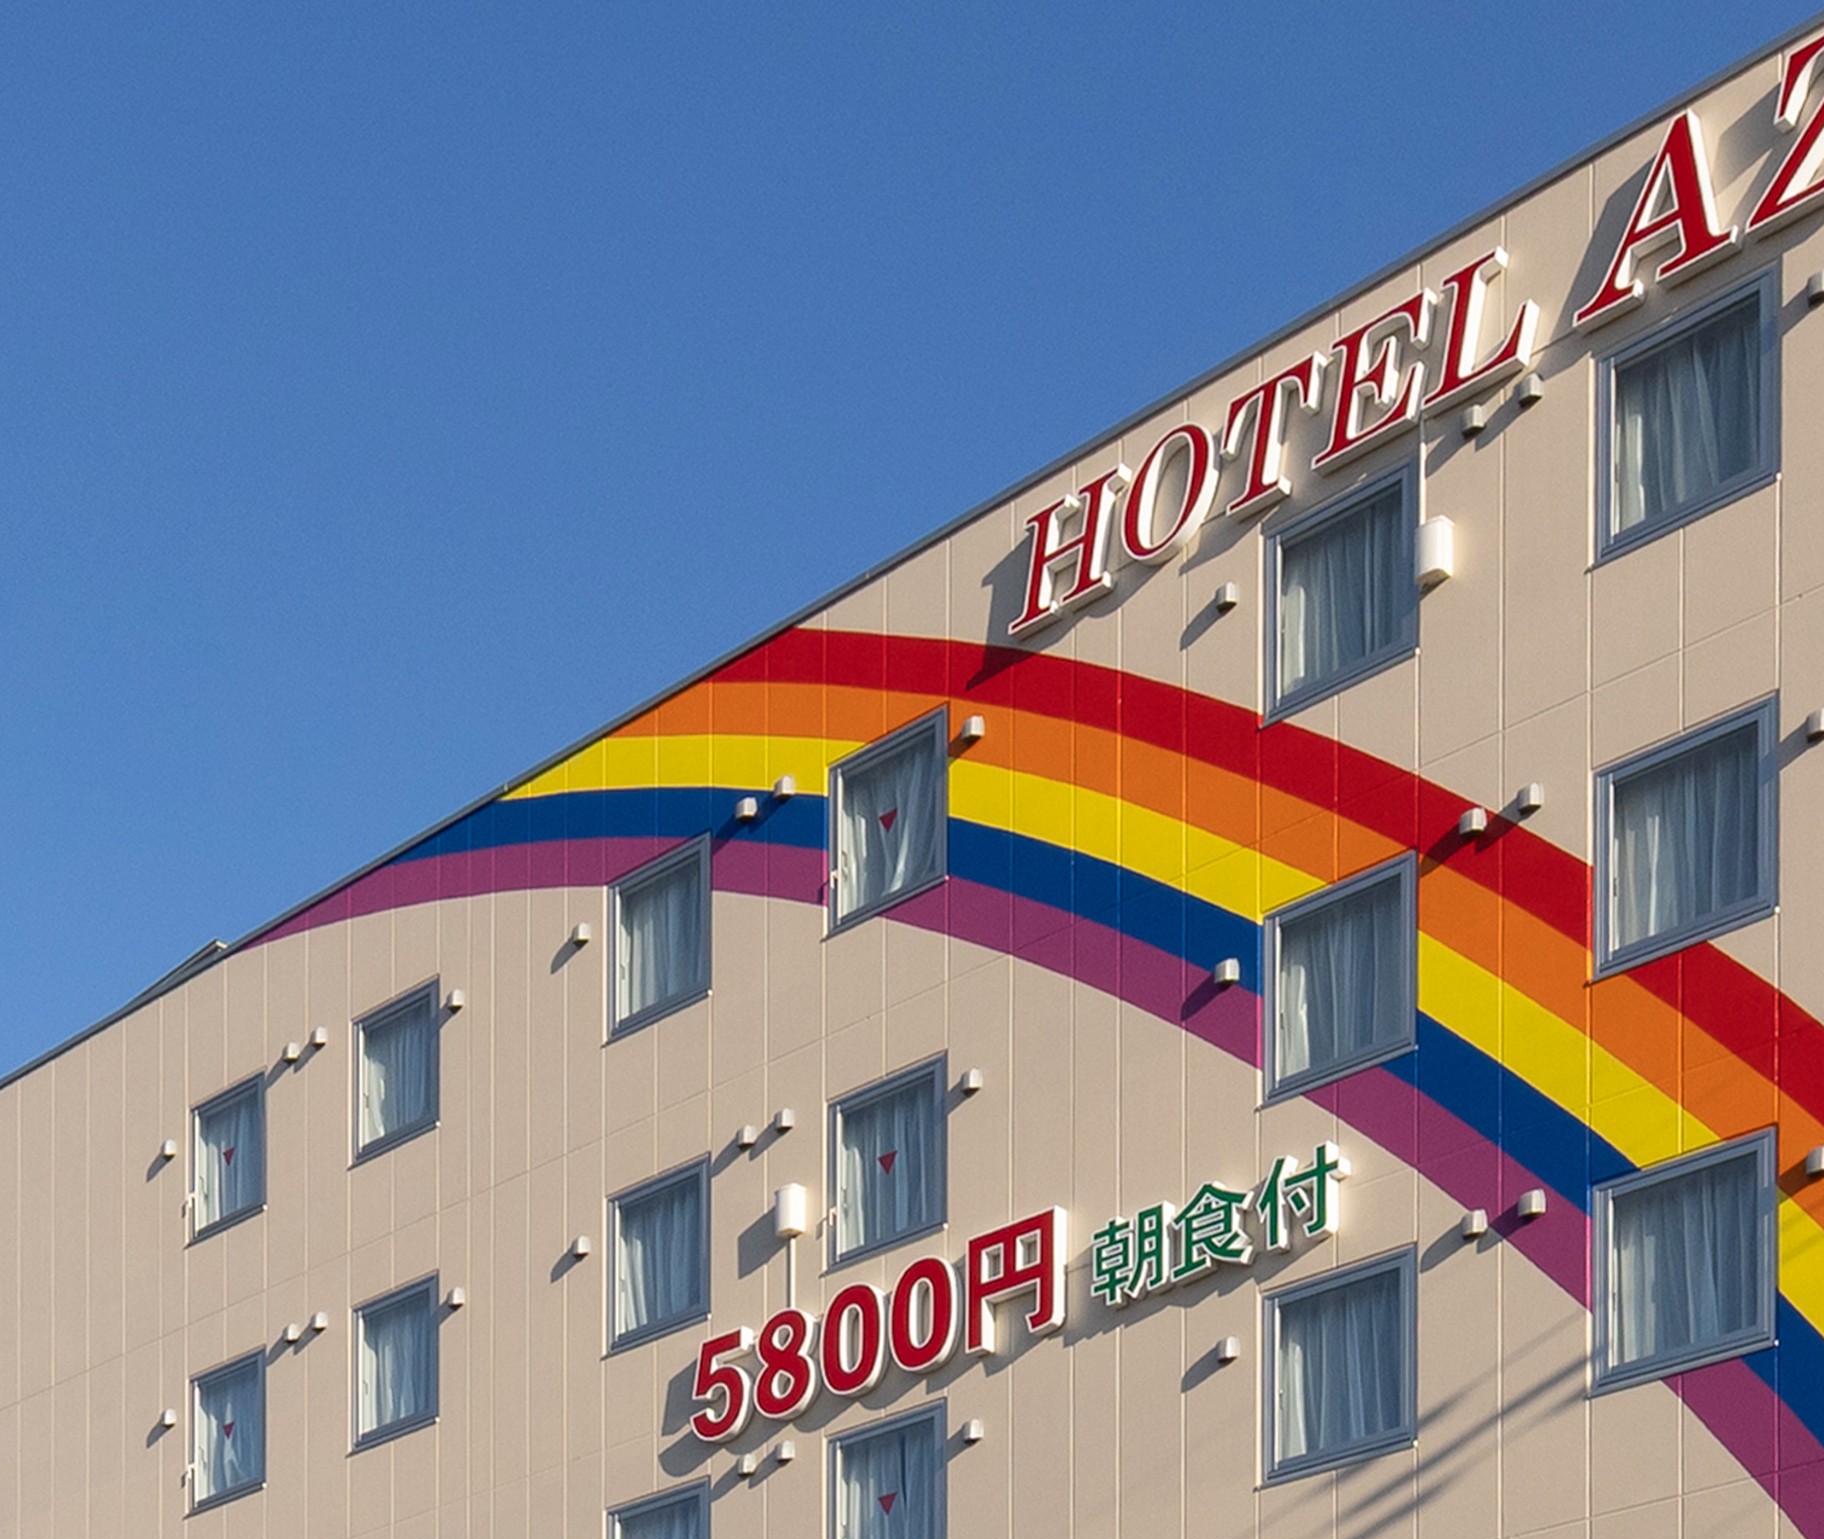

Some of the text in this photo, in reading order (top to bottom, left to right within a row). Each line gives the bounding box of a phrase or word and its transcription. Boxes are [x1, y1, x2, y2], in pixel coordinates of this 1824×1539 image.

[1008, 246, 1539, 636] HOTEL
[690, 1140, 1348, 1443] 5800円 朝食付
